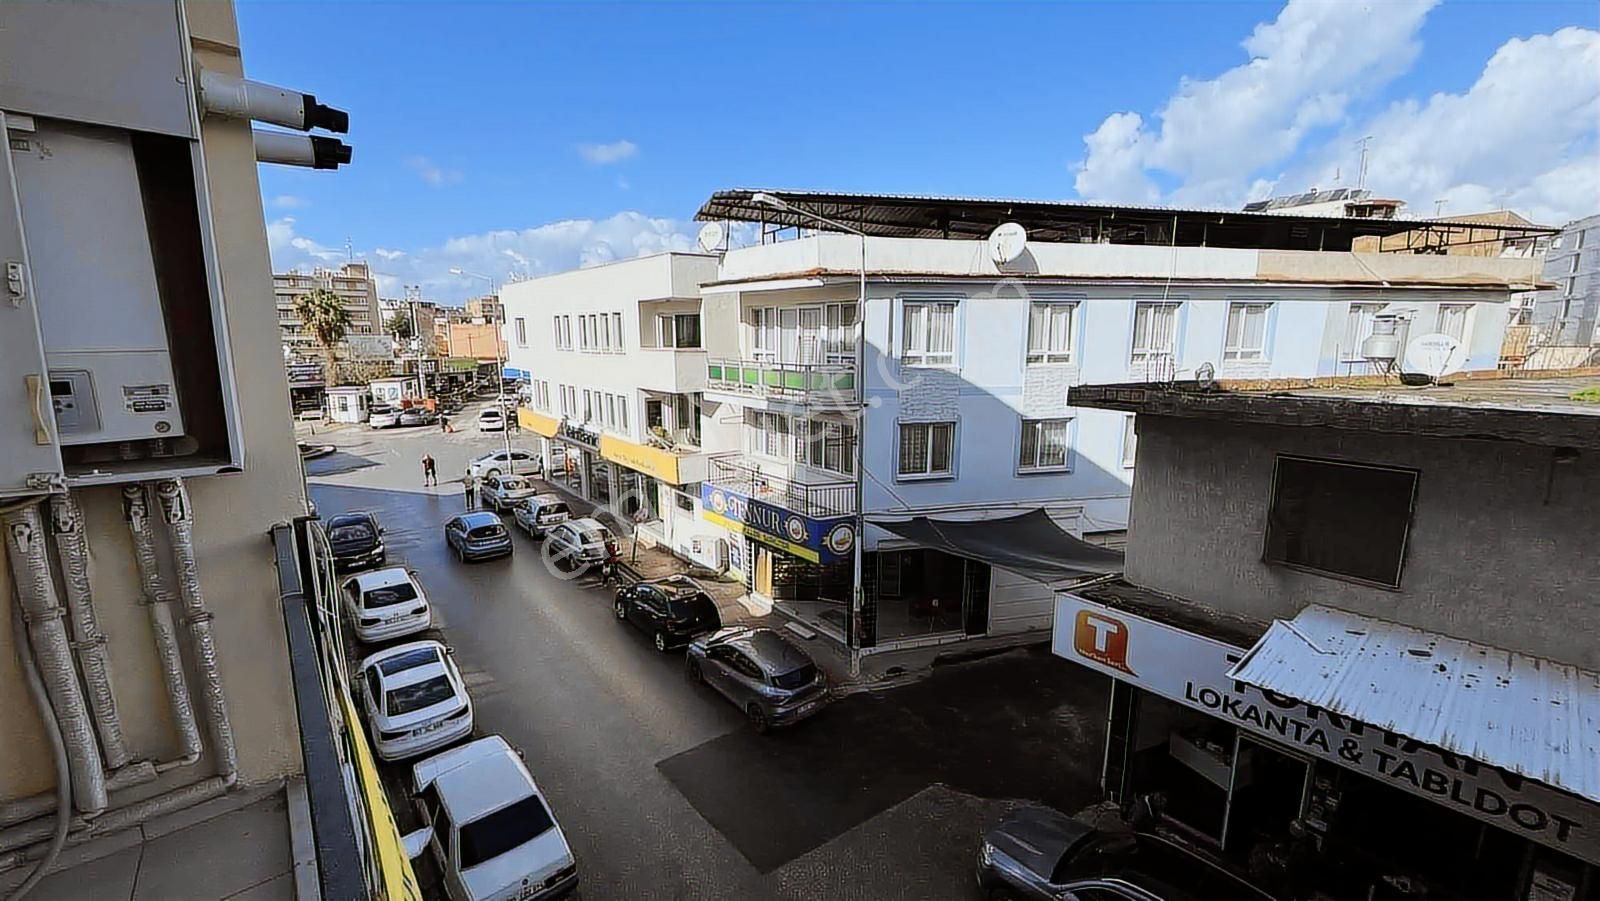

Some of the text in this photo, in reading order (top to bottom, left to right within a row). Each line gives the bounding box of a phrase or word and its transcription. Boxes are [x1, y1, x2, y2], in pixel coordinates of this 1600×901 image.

[1087, 616, 1118, 652] T
[1185, 682, 1329, 752] LOKANTA
[1338, 739, 1363, 764] &
[1373, 749, 1582, 841] TABLDOT
